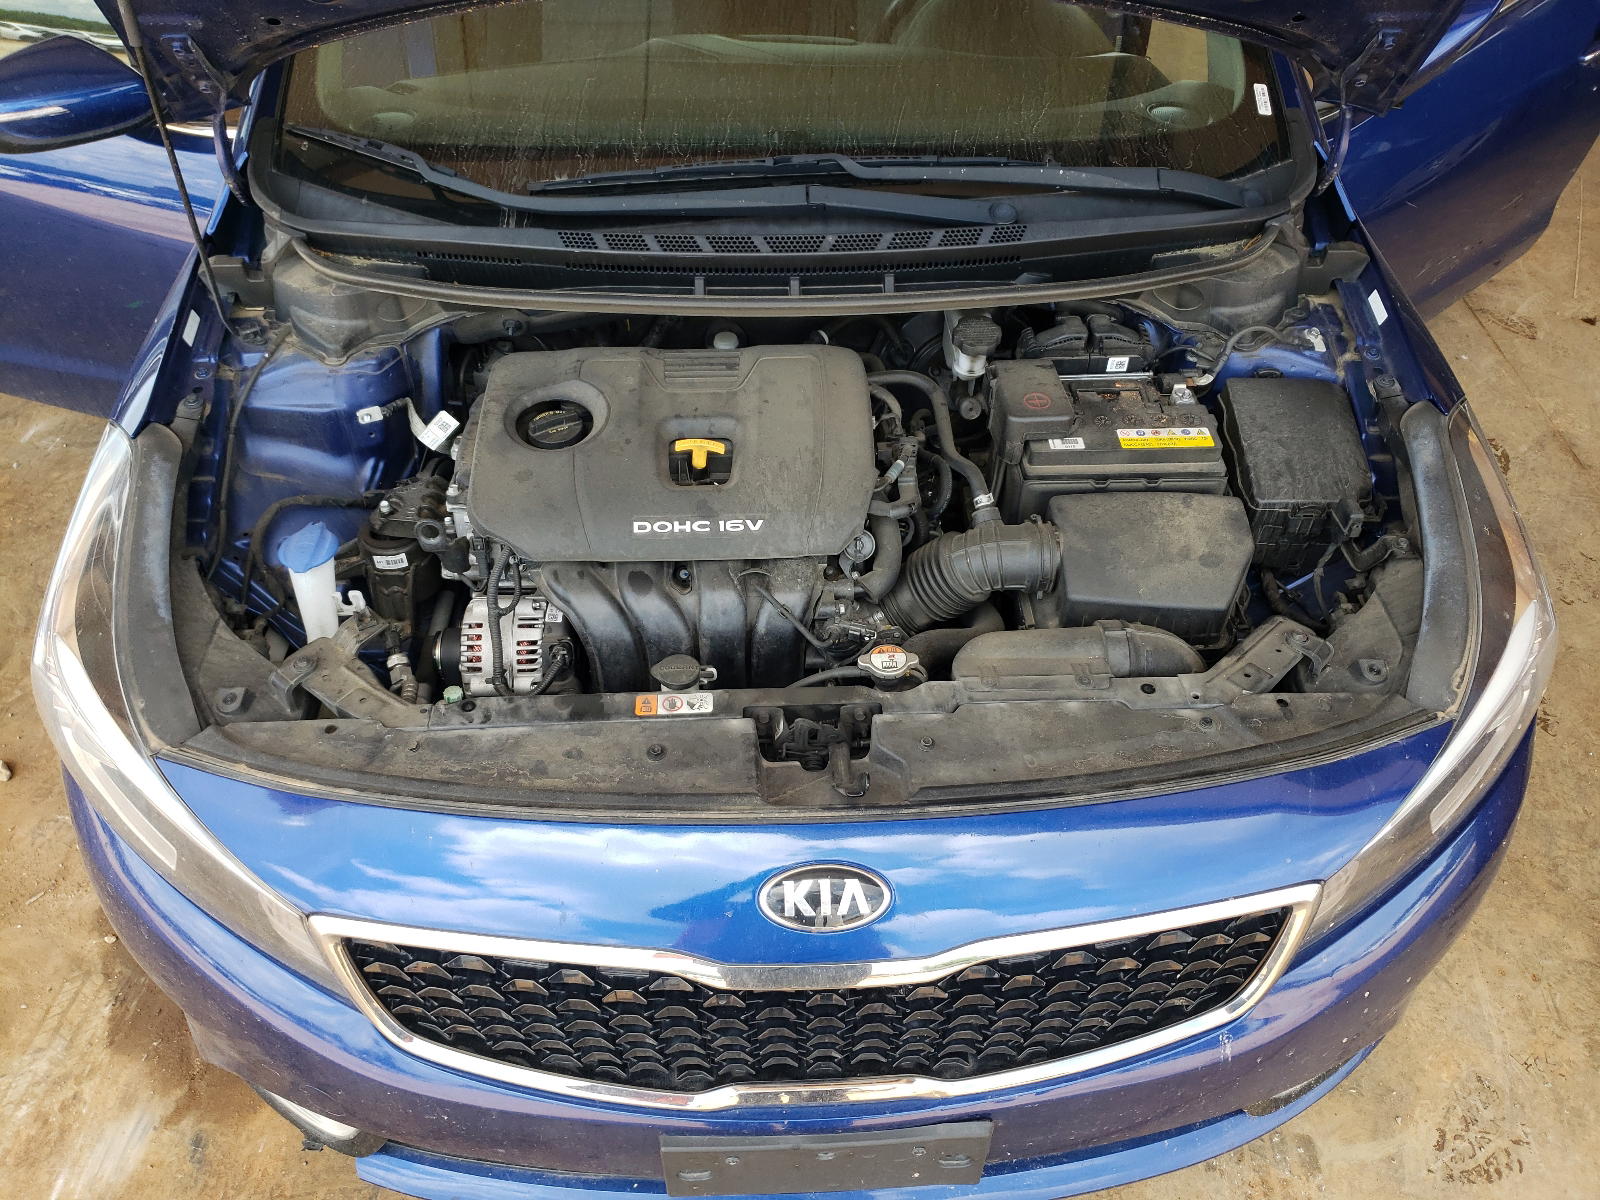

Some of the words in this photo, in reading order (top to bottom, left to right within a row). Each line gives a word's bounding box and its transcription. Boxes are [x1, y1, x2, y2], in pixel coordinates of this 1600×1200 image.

[633, 520, 711, 533] DOHC
[718, 519, 764, 532] 16V
[782, 878, 871, 917] KIA
